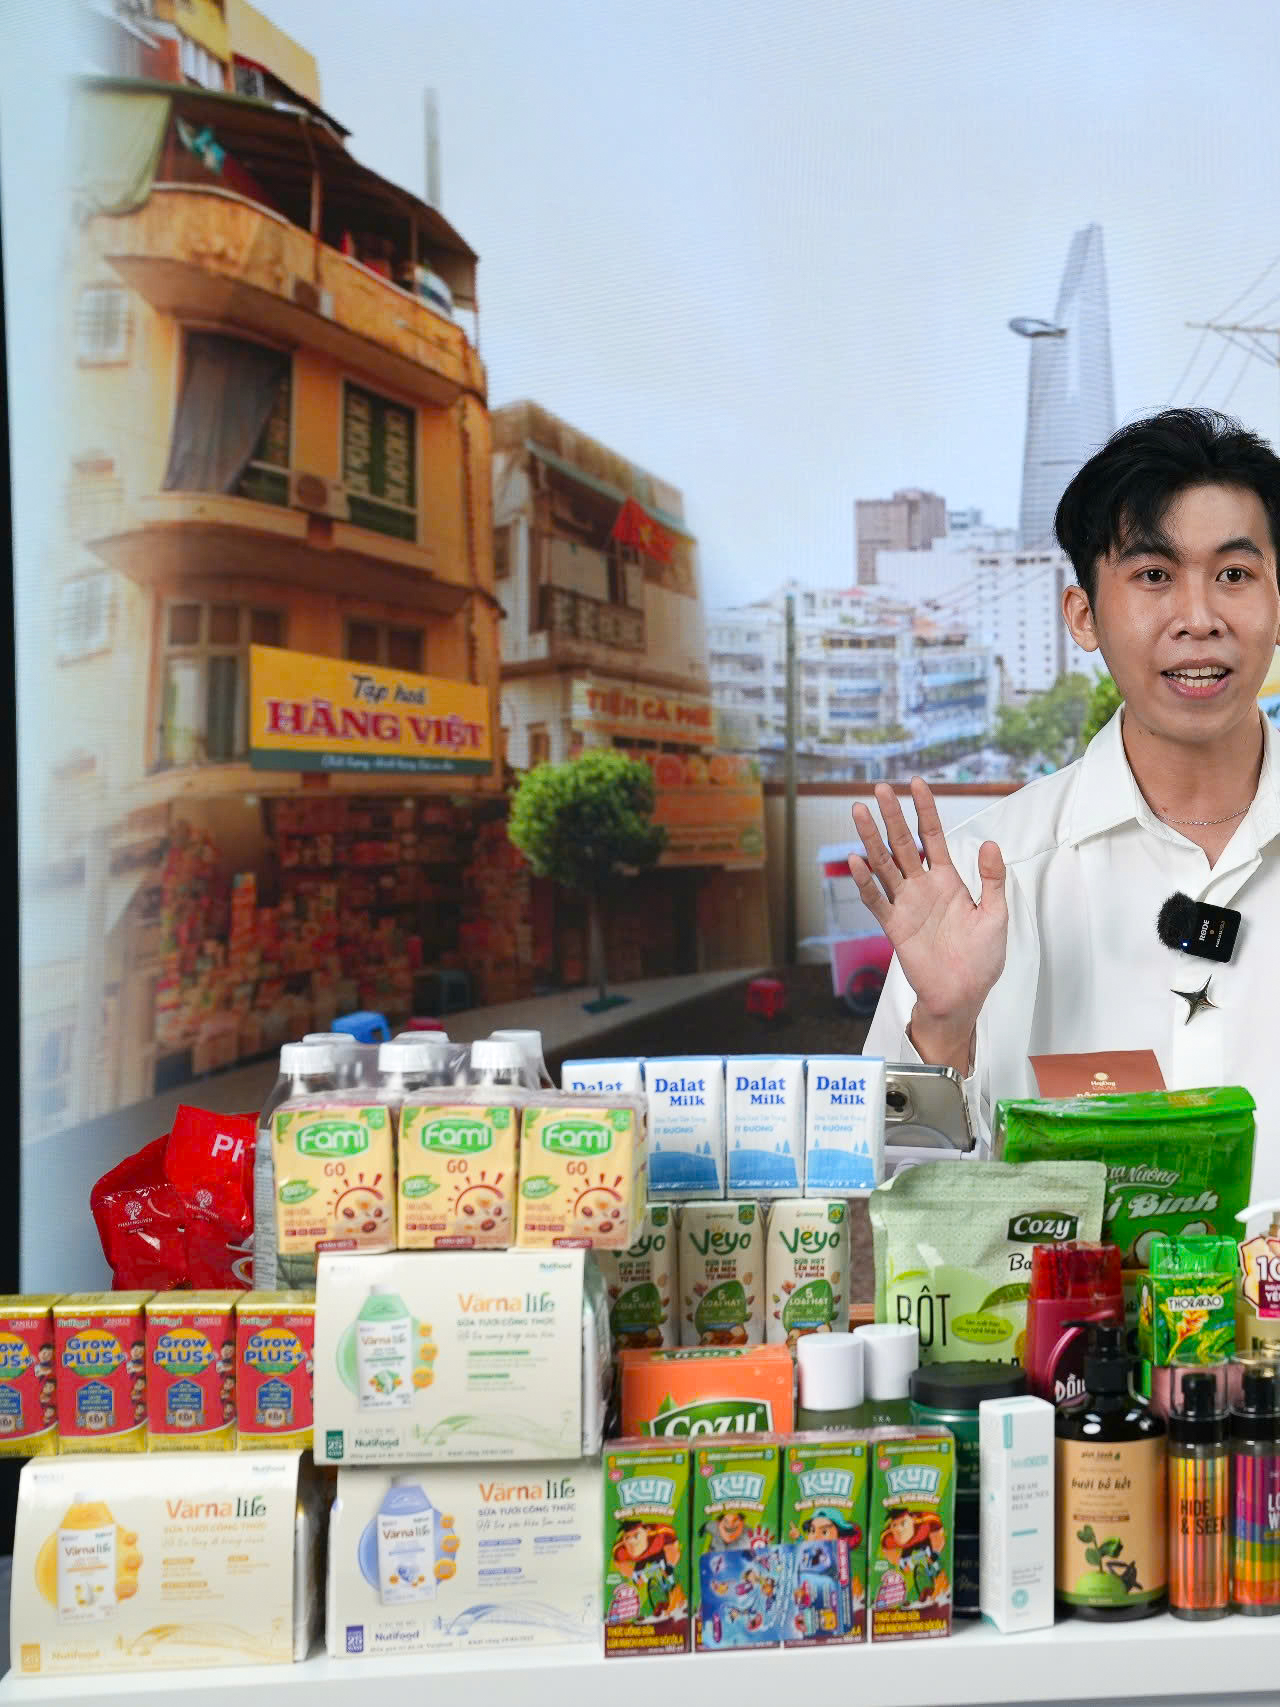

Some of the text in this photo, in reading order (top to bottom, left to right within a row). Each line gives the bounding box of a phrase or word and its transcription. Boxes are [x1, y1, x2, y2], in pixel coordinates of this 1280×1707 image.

[407, 714, 484, 752] VIỆT
[655, 1078, 705, 1093] Dalat
[736, 1077, 786, 1091] Dalat
[816, 1076, 866, 1091] Dalat
[670, 1094, 705, 1106] Milk
[750, 1093, 786, 1105] Milk
[830, 1093, 865, 1105] Milk
[324, 1162, 346, 1178] GO
[447, 1159, 468, 1174] GO
[567, 1161, 588, 1176] GO
[1013, 1214, 1072, 1241] Cozy
[689, 1226, 752, 1256] Veyo
[779, 1226, 841, 1255] Veyo
[526, 1291, 556, 1313] life
[1168, 1295, 1222, 1310] THORAKAO
[897, 1285, 951, 1352] BỘT
[67, 1337, 117, 1350] Grow
[159, 1335, 208, 1348] Grow
[249, 1335, 297, 1348] Grow
[62, 1351, 126, 1367] PLUS+
[153, 1350, 217, 1365] PLUS+
[244, 1350, 306, 1364] PLUS+
[546, 1478, 576, 1499] life
[236, 1496, 267, 1517] life
[1181, 1498, 1210, 1515] HIDE
